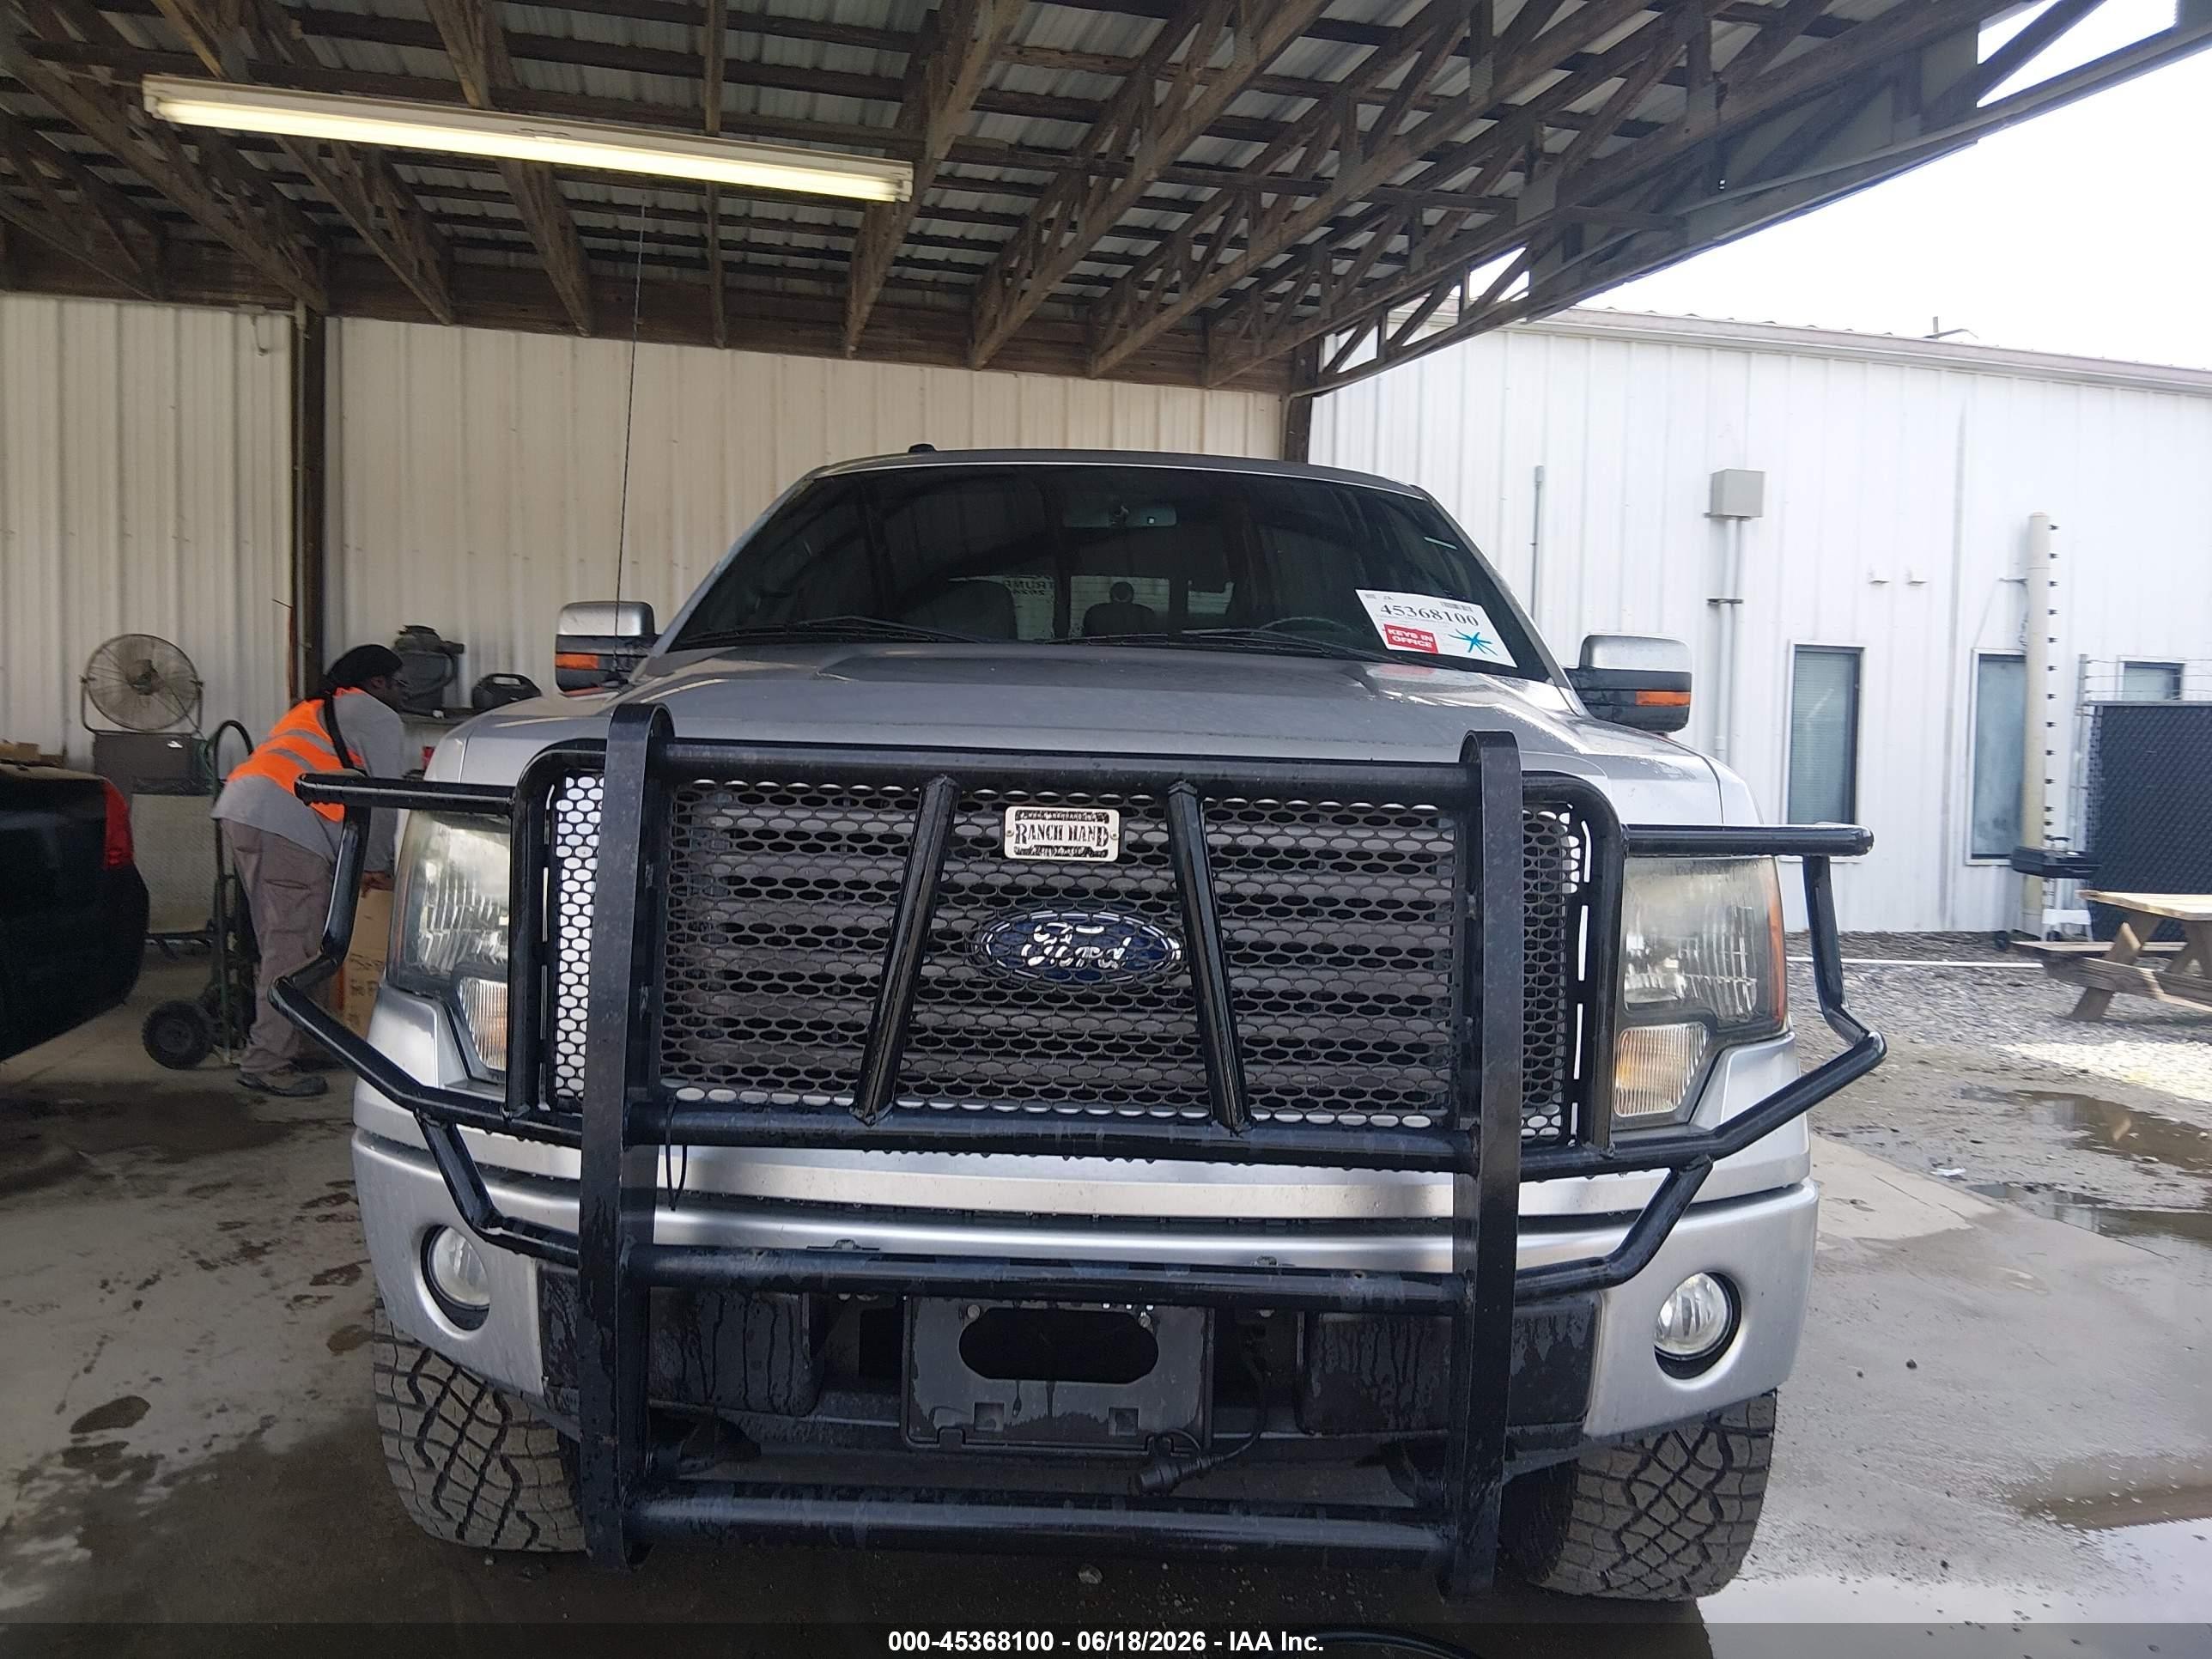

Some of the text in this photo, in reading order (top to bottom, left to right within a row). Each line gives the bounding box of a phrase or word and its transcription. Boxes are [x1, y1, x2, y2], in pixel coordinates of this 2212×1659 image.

[1380, 604, 1480, 627] 45368100
[1387, 629, 1434, 642] KEYS IN
[1391, 635, 1433, 648] OFFICE
[1015, 823, 1109, 847] RANCH HAND
